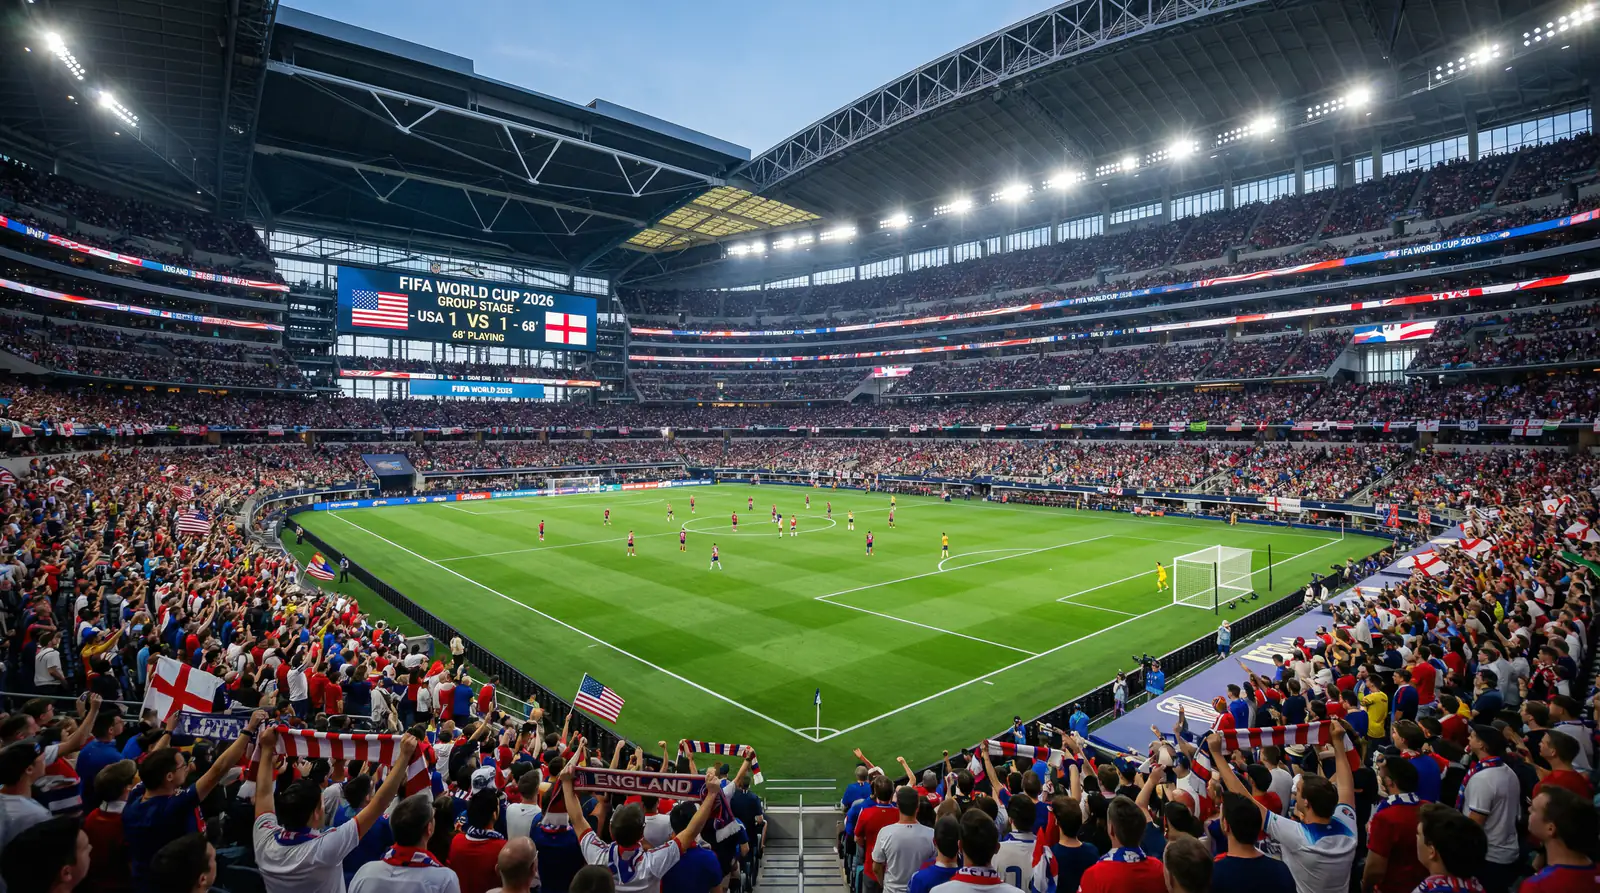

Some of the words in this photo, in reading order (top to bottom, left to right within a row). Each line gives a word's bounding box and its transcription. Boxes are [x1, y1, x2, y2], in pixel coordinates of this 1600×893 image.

[1396, 248, 1413, 257] FIFA
[1413, 243, 1441, 254] WORLD
[1442, 240, 1459, 249] CUP
[400, 276, 433, 293] FIFA
[436, 280, 488, 299] WORLD
[492, 288, 520, 302] CUP
[523, 292, 554, 307] 2026
[438, 296, 477, 309] GROUP
[479, 300, 514, 314] STAGE
[417, 310, 444, 323] USA
[448, 311, 457, 326] 1
[467, 313, 489, 329] VS
[500, 317, 507, 331] 1
[522, 320, 539, 332] 68'
[452, 330, 466, 339] 68'
[468, 331, 505, 342] PLAYING
[452, 385, 469, 393] FIFA
[471, 386, 496, 394] WORLD
[594, 773, 692, 793] ENGLAND
